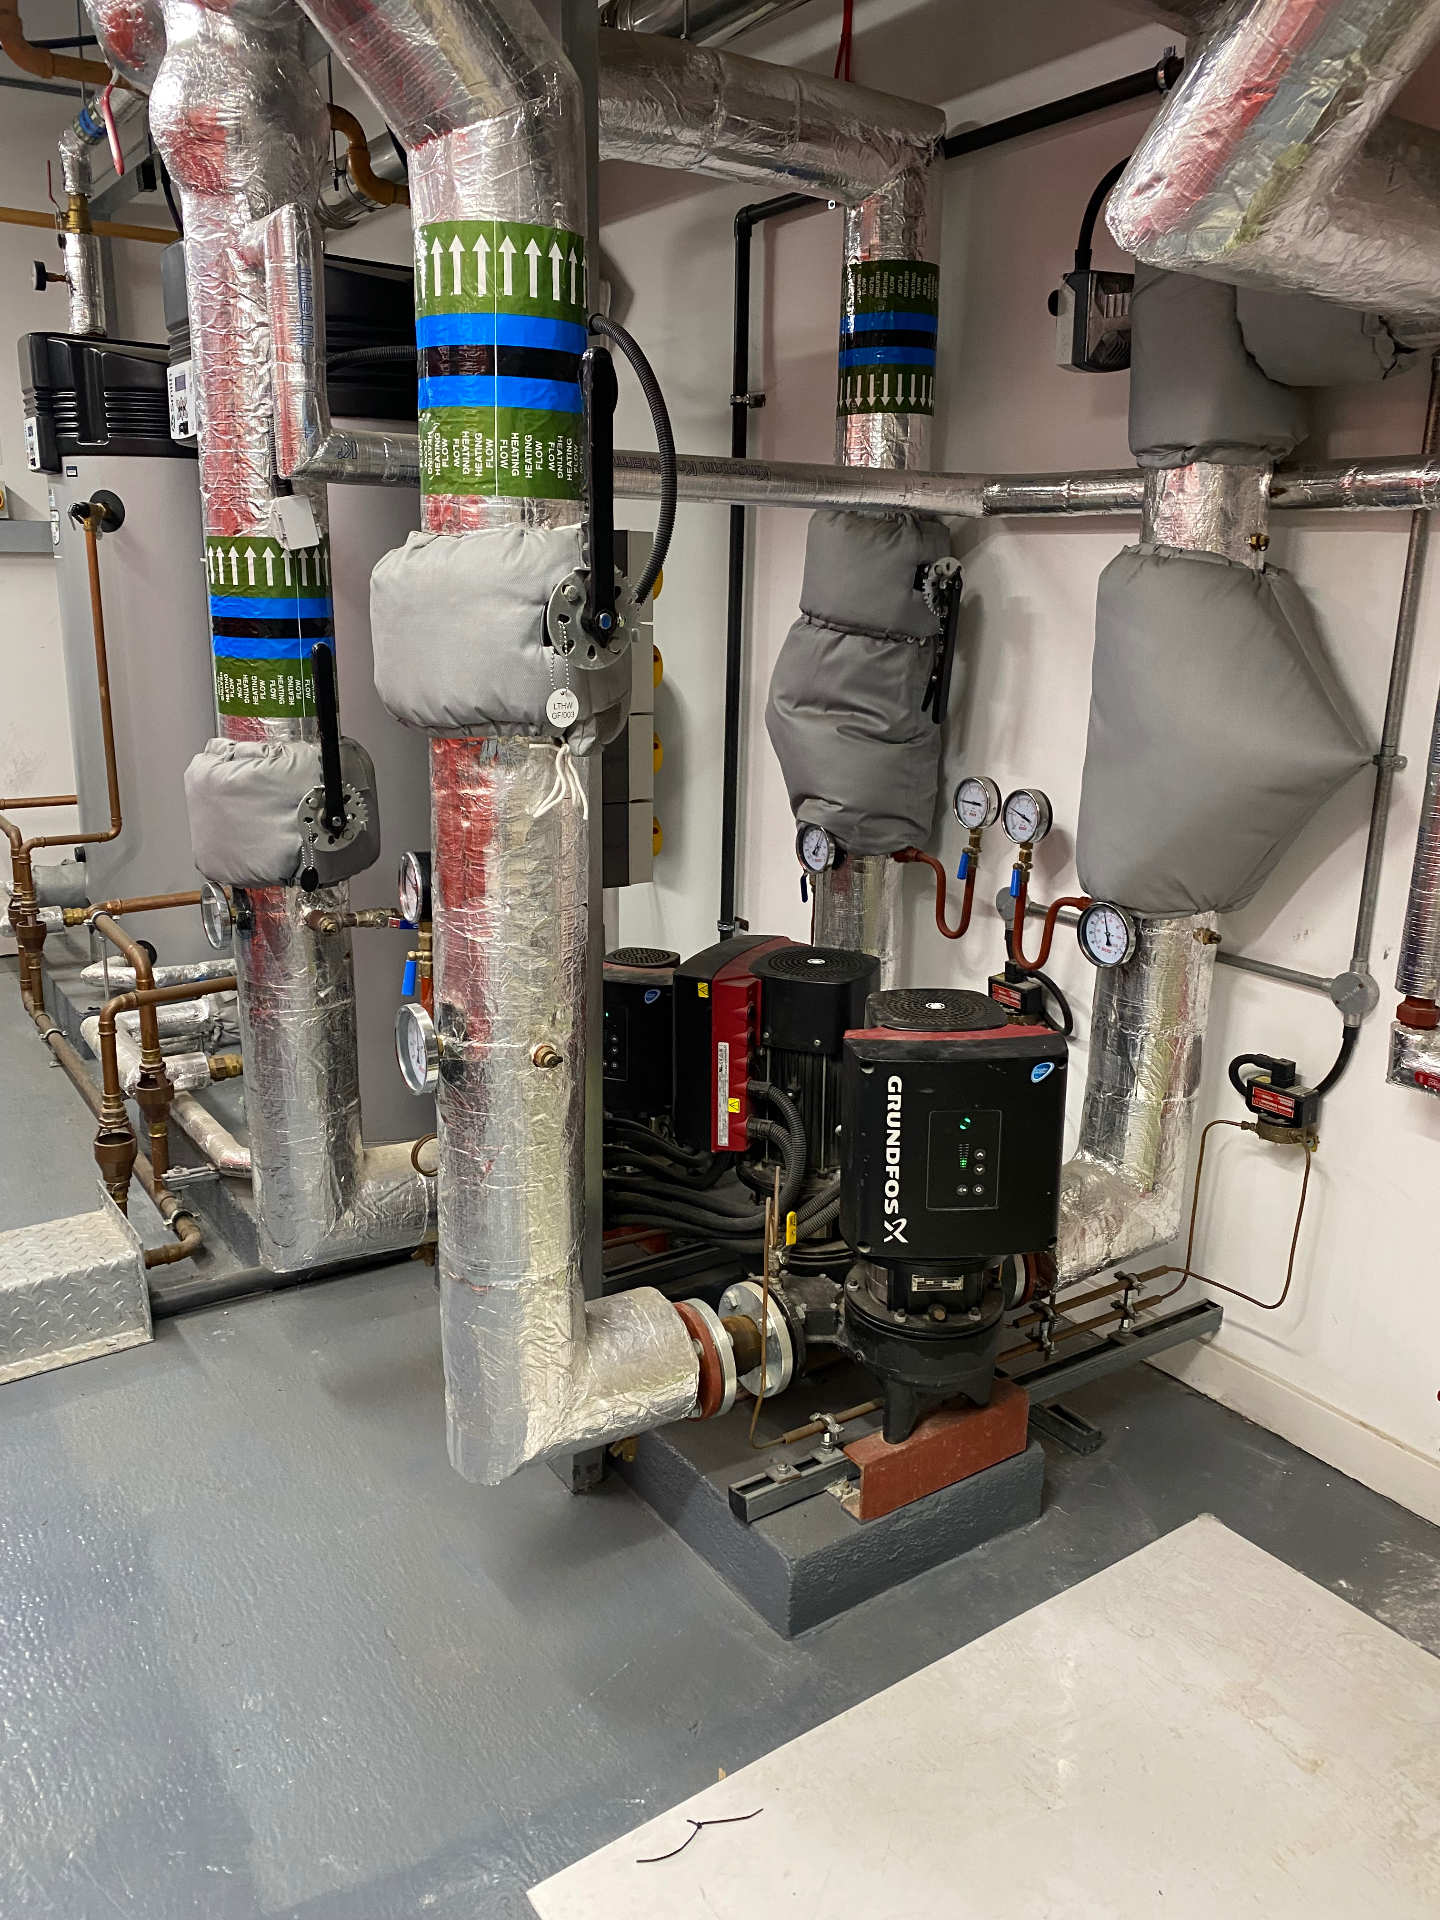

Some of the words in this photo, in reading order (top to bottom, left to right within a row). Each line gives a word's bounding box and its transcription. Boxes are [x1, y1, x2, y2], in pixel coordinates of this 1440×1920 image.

[486, 438, 494, 468] FLOW
[500, 440, 508, 469] FLOW
[511, 433, 519, 476] HEATING
[884, 1075, 902, 1214] GRUNDFOS
